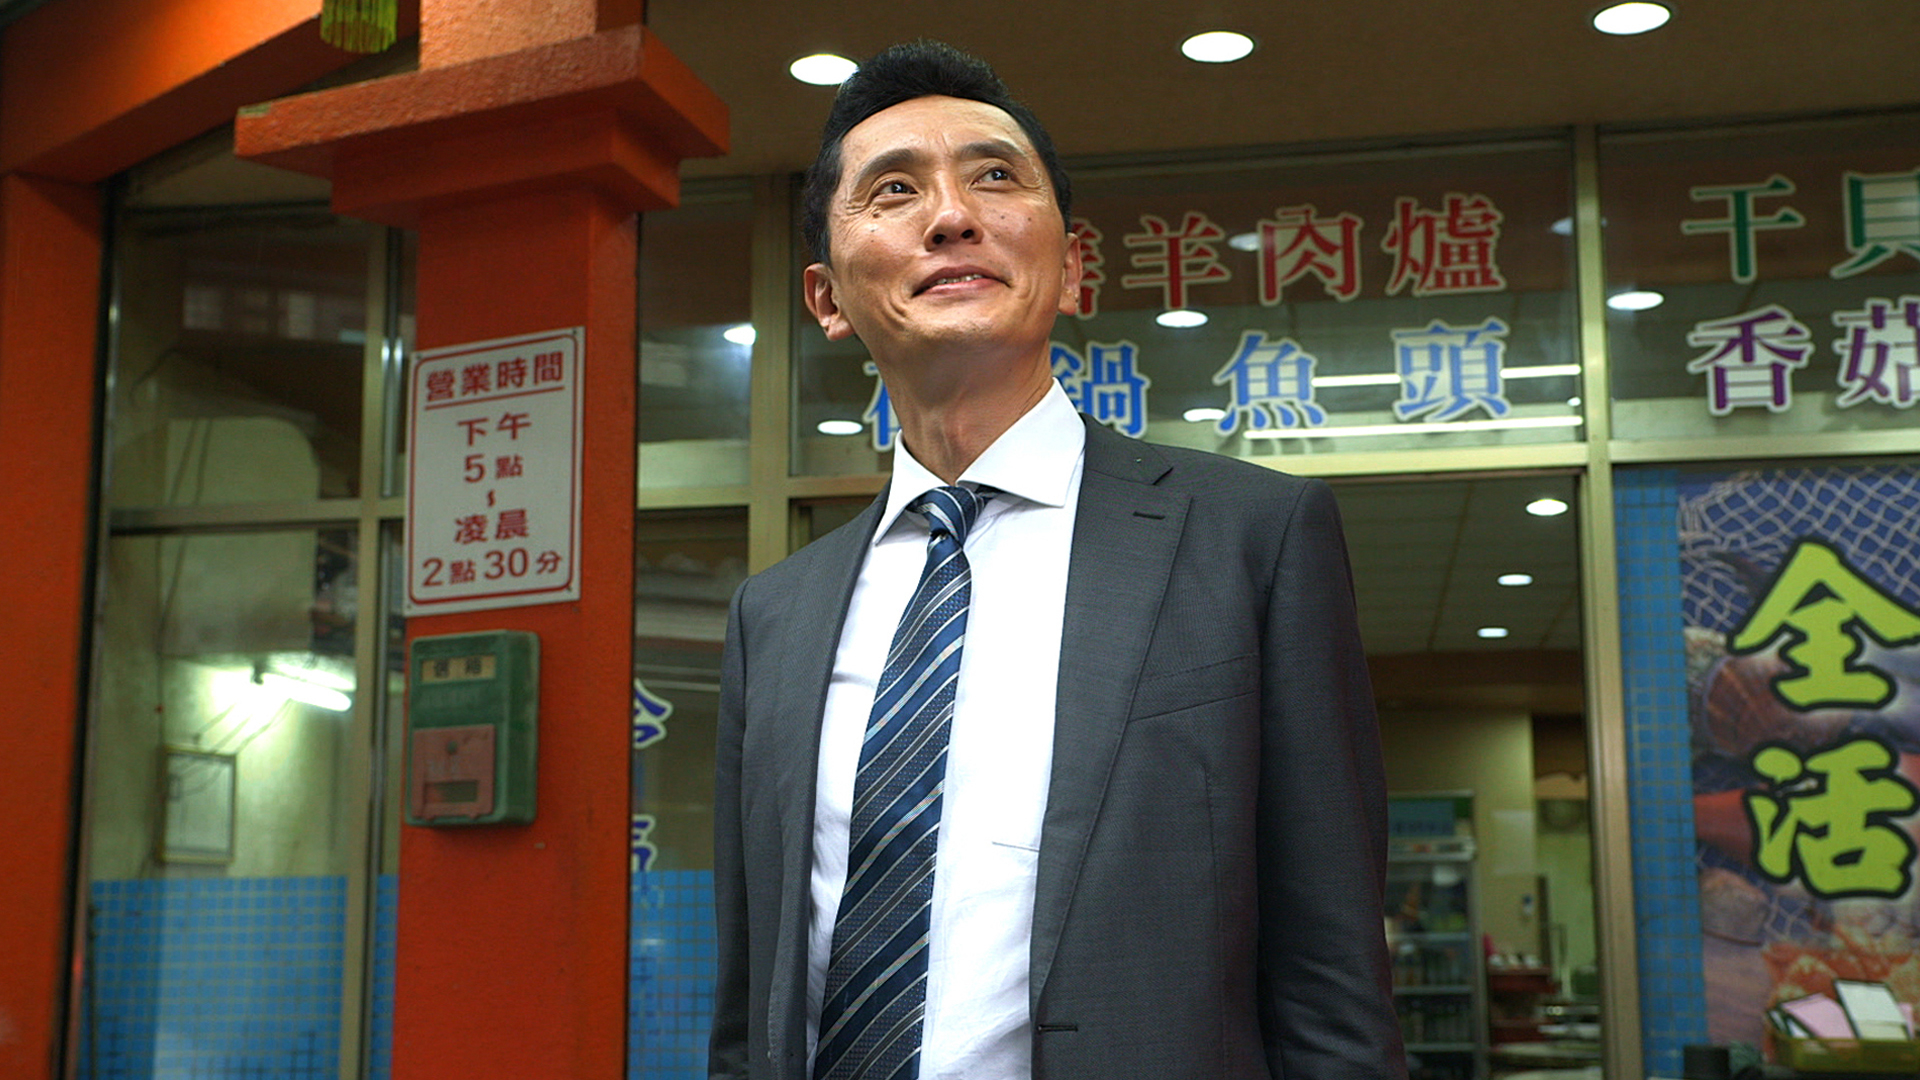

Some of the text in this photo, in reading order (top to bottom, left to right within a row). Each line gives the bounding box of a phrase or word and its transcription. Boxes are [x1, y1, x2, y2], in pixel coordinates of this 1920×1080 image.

[1681, 170, 1920, 282] 干貝
[427, 351, 564, 402] 營業時間
[1687, 298, 1920, 414] 香菇
[863, 318, 1509, 450] 鍋魚頭
[457, 412, 532, 446] 下午
[464, 453, 524, 483] 5點
[454, 508, 529, 545] 凌晨
[422, 547, 562, 587] 2點30分
[1727, 538, 1920, 899] 全活
